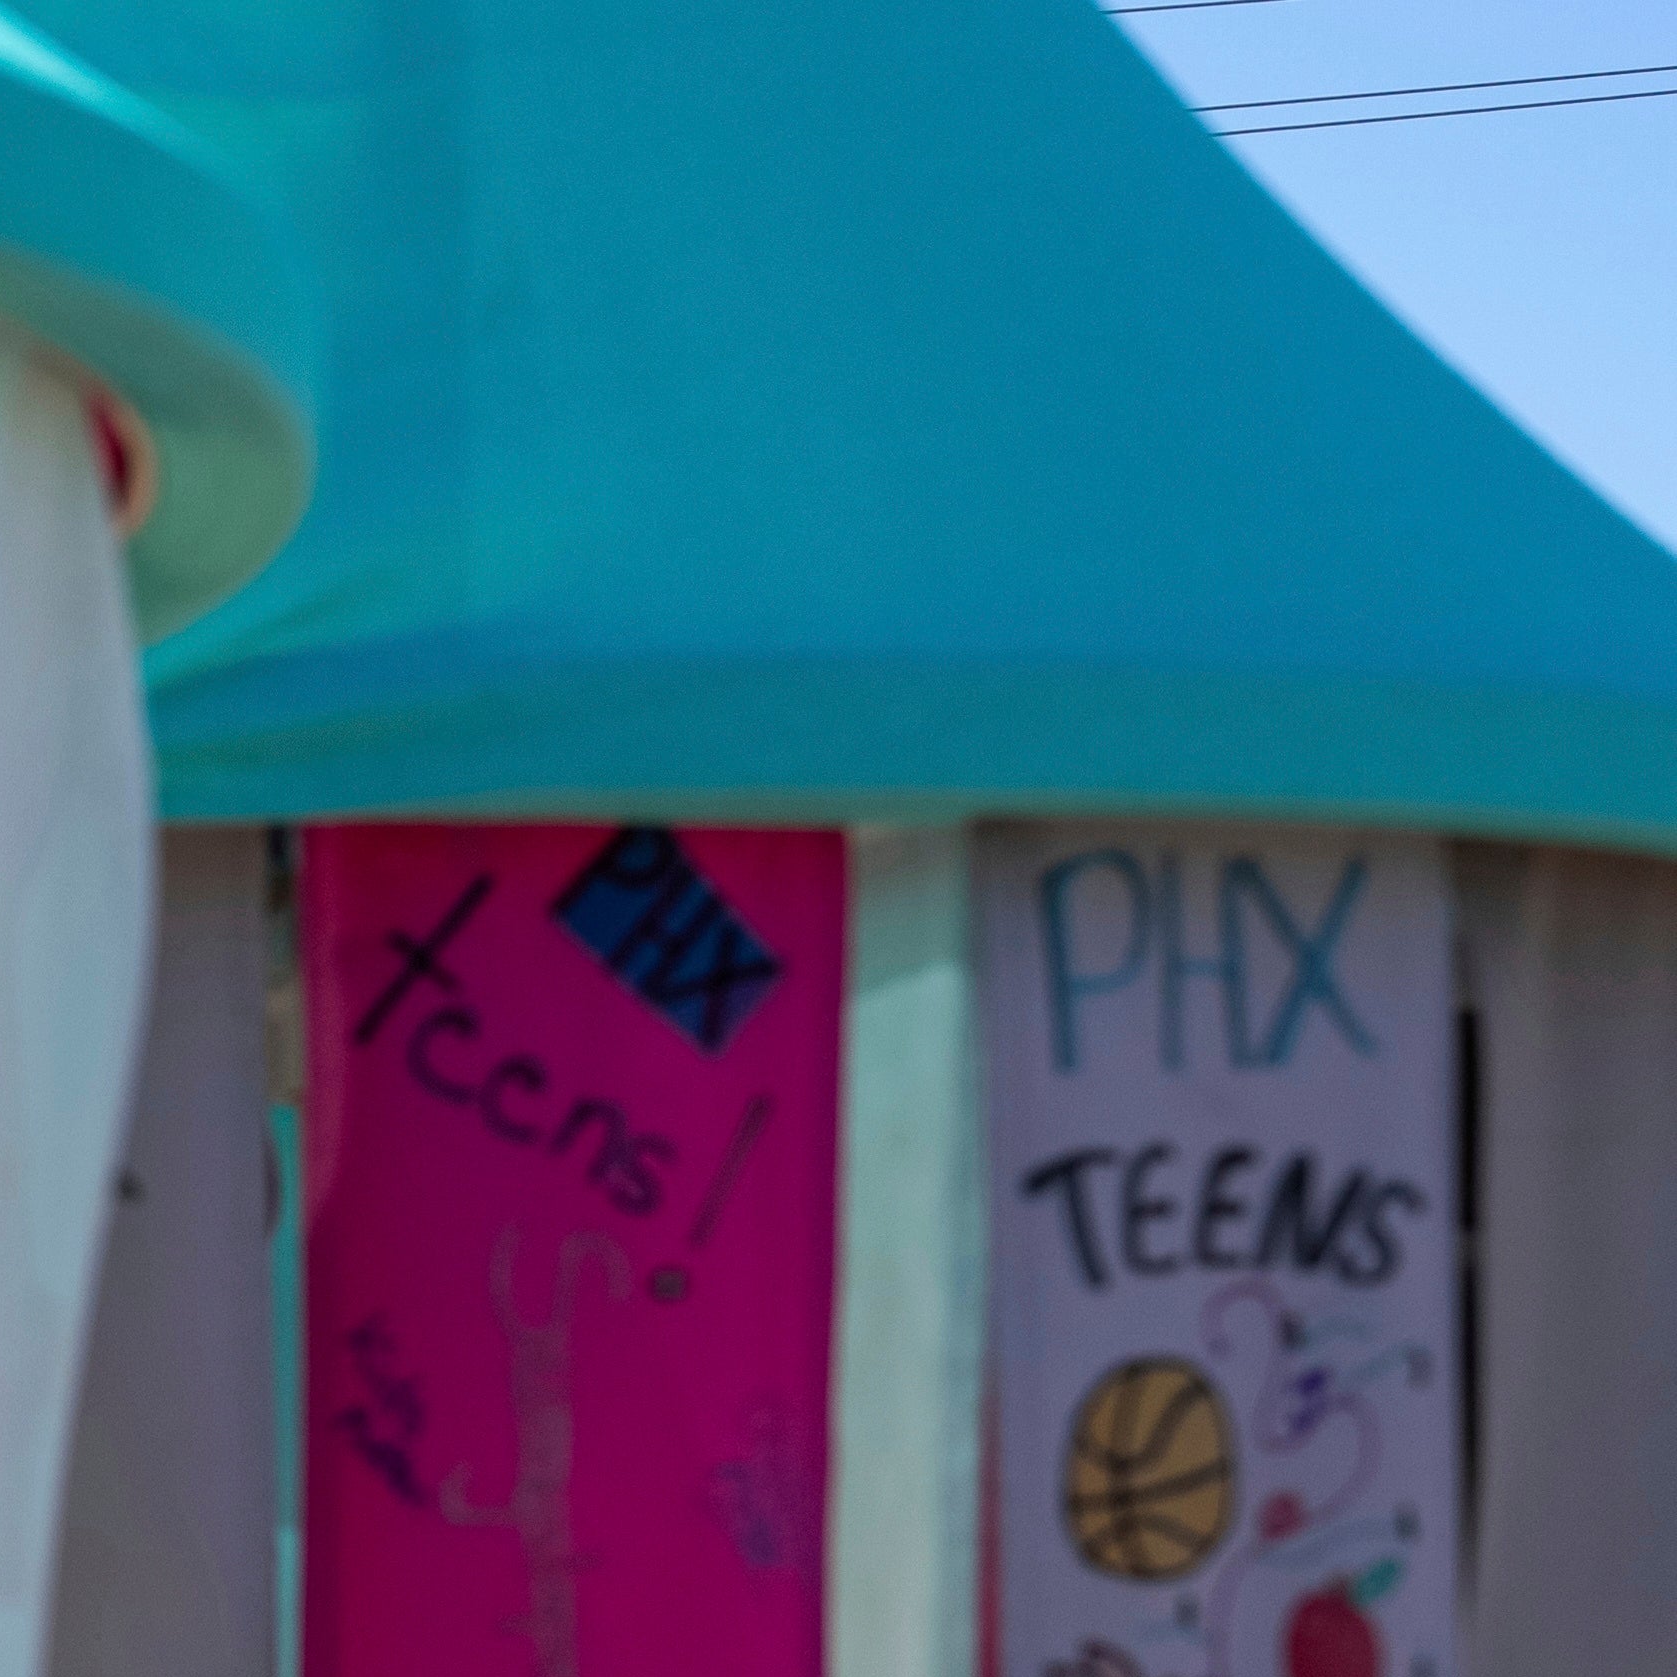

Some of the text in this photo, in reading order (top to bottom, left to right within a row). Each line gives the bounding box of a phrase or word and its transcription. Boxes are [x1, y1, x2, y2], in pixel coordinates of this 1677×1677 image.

[549, 822, 784, 1048] PHX
[1034, 845, 1380, 1074] PHX
[1021, 1137, 1430, 1290] TEENS
